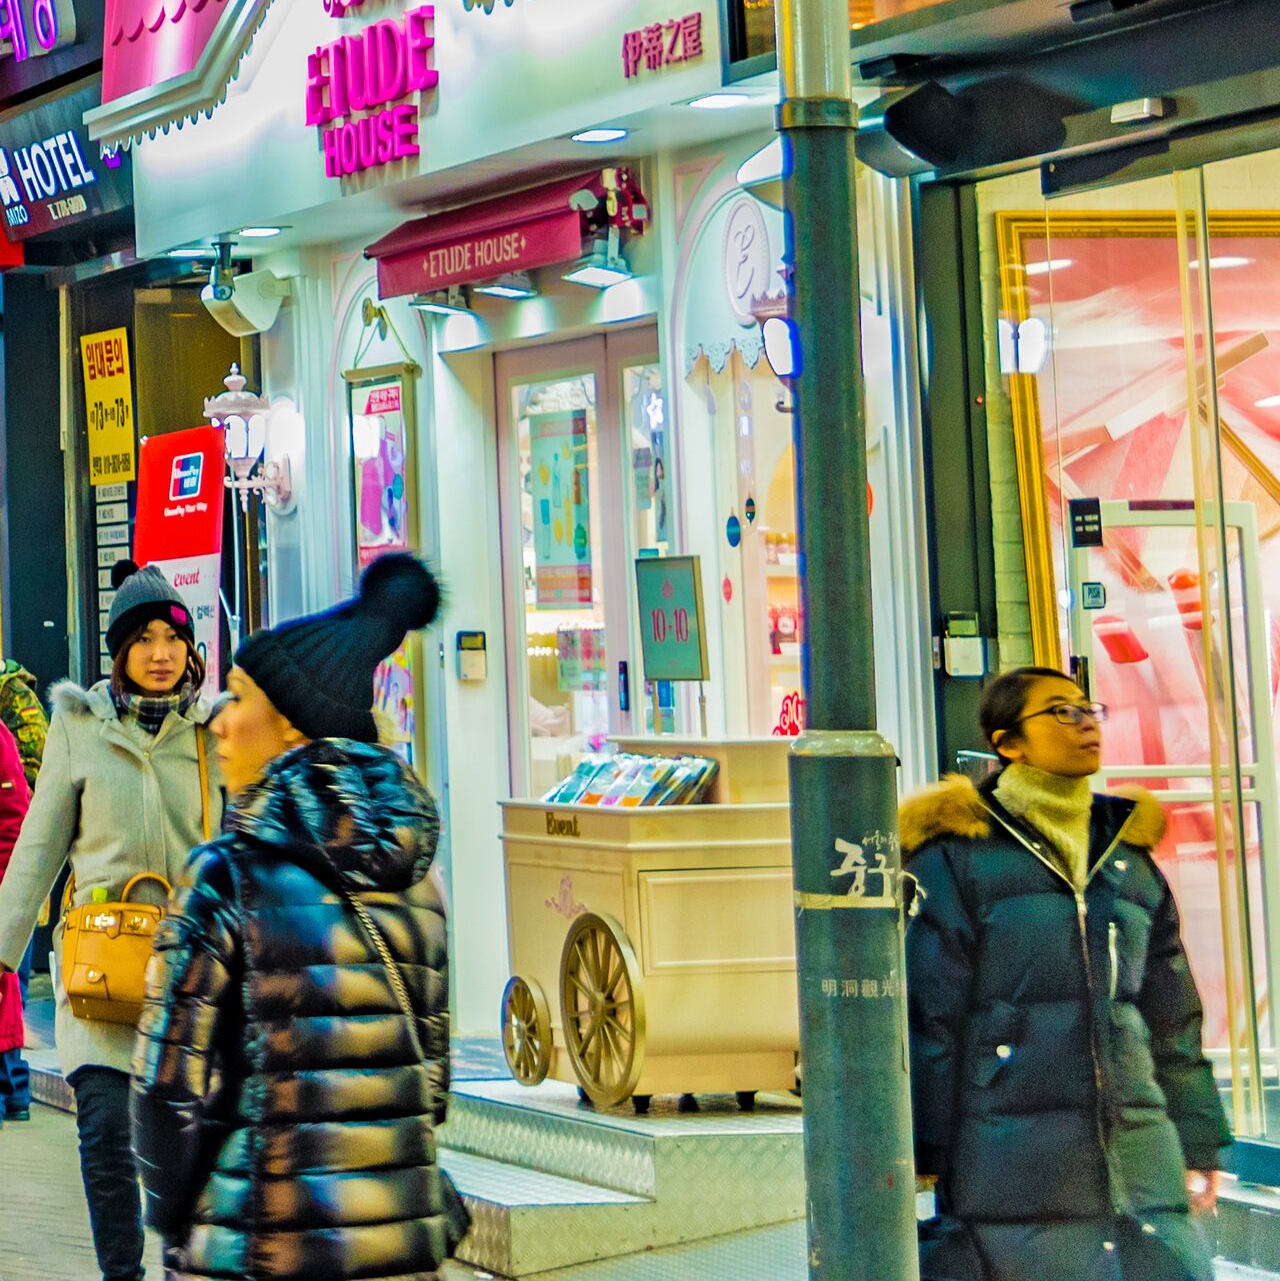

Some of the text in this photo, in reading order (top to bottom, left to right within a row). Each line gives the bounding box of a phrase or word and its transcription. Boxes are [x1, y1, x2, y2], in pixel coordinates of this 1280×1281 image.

[304, 4, 440, 127] ETUDE
[620, 11, 703, 79] 伊蒂之屋
[12, 129, 97, 203] HOTEL
[323, 104, 420, 178] HOUSE
[4, 204, 30, 226] MIZO
[428, 231, 520, 279] ETUDE HOUSE
[85, 337, 126, 380] 임대문의
[174, 567, 201, 588] event
[829, 837, 896, 898] 중구
